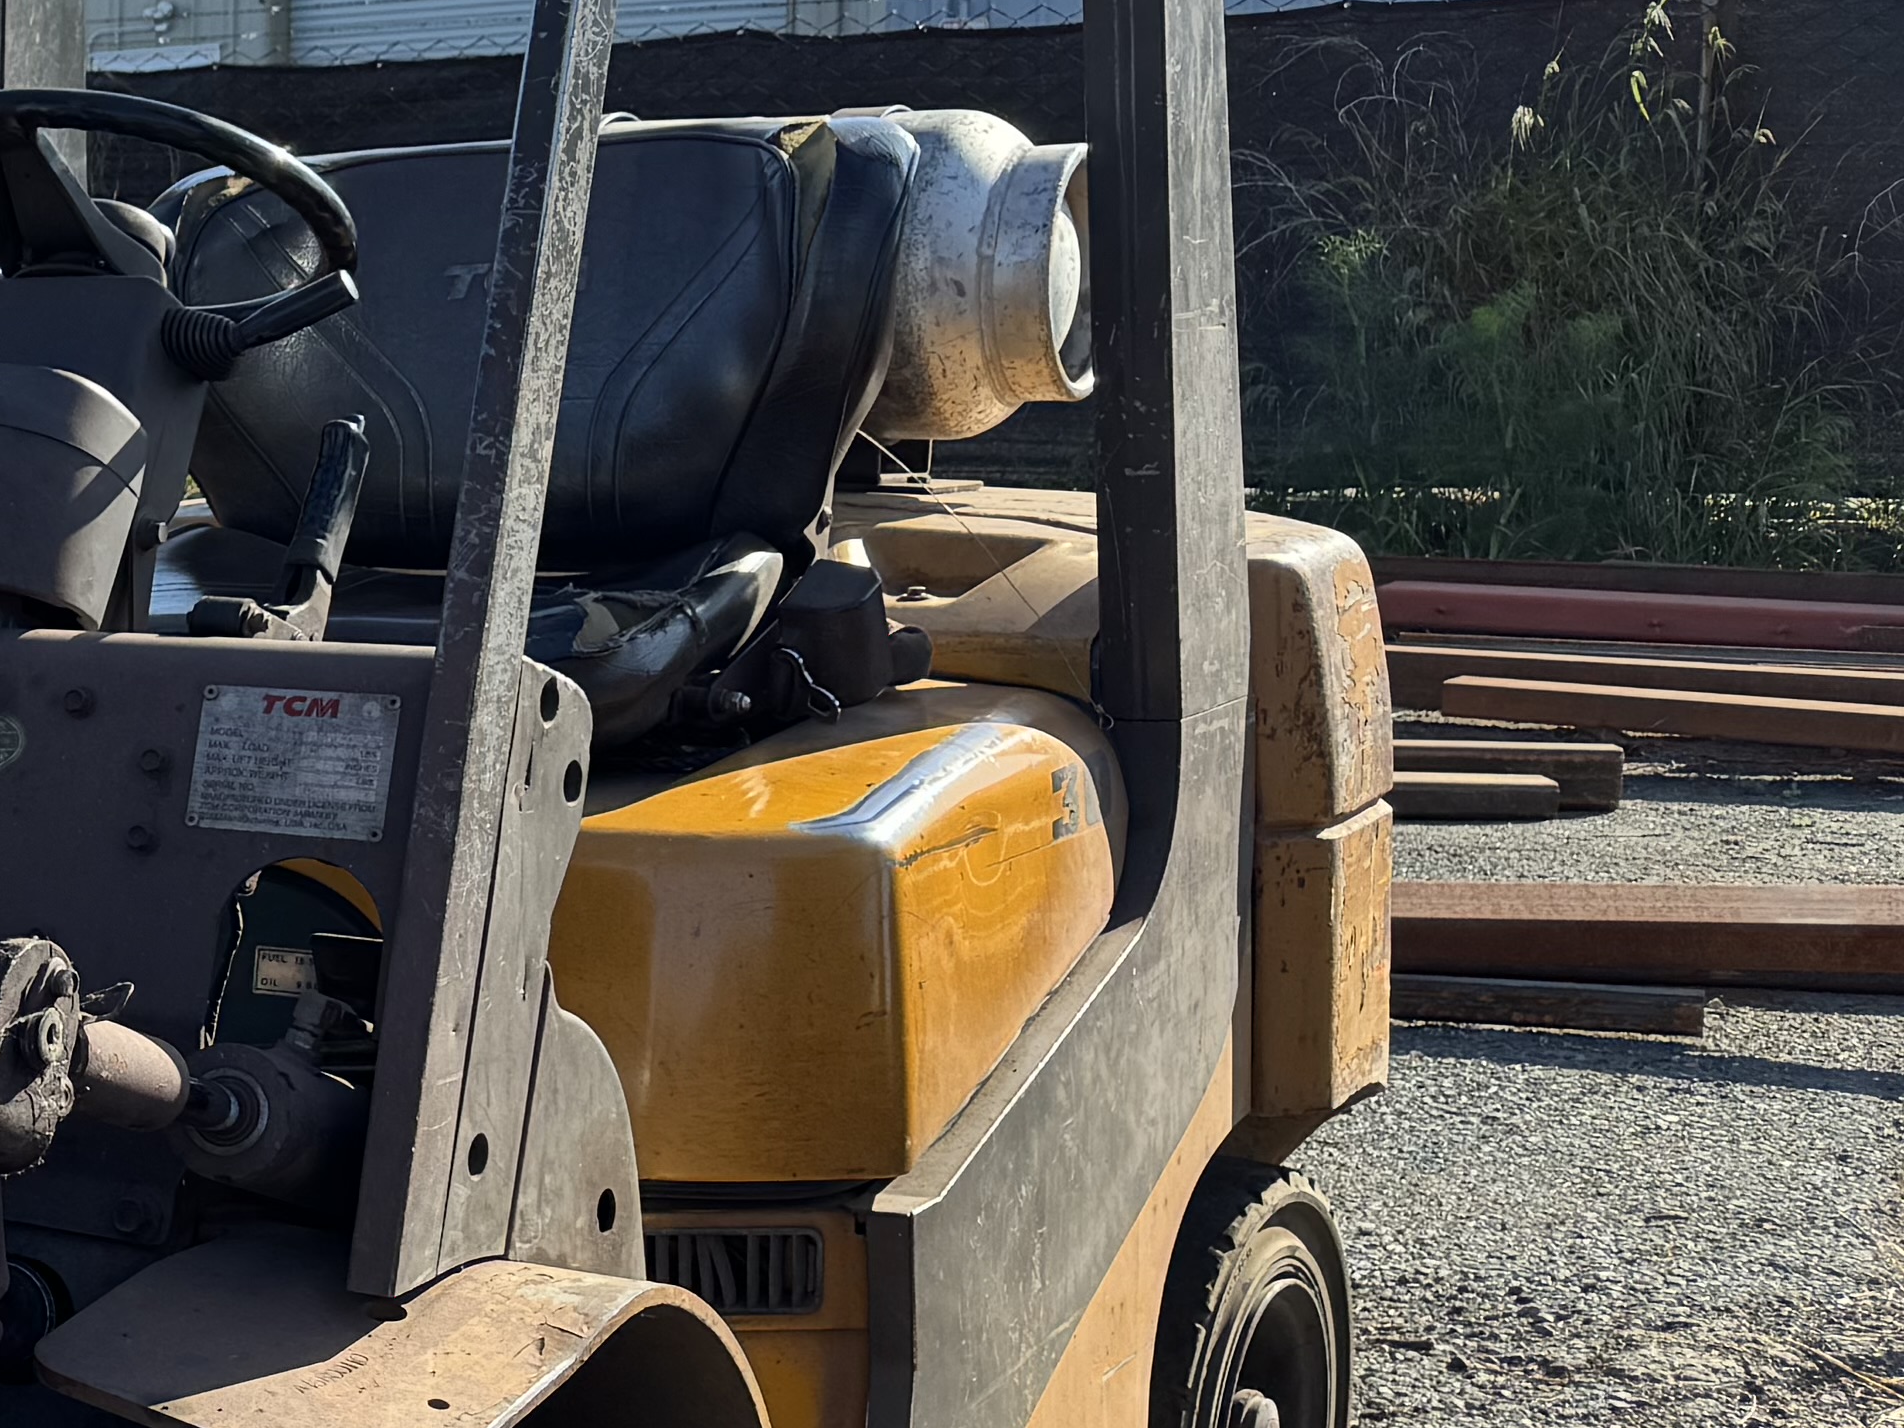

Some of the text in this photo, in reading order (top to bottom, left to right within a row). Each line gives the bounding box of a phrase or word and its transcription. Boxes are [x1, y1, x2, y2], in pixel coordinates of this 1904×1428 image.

[262, 693, 341, 719] TCM
[261, 953, 288, 964] FUEL
[261, 977, 278, 987] OIL
